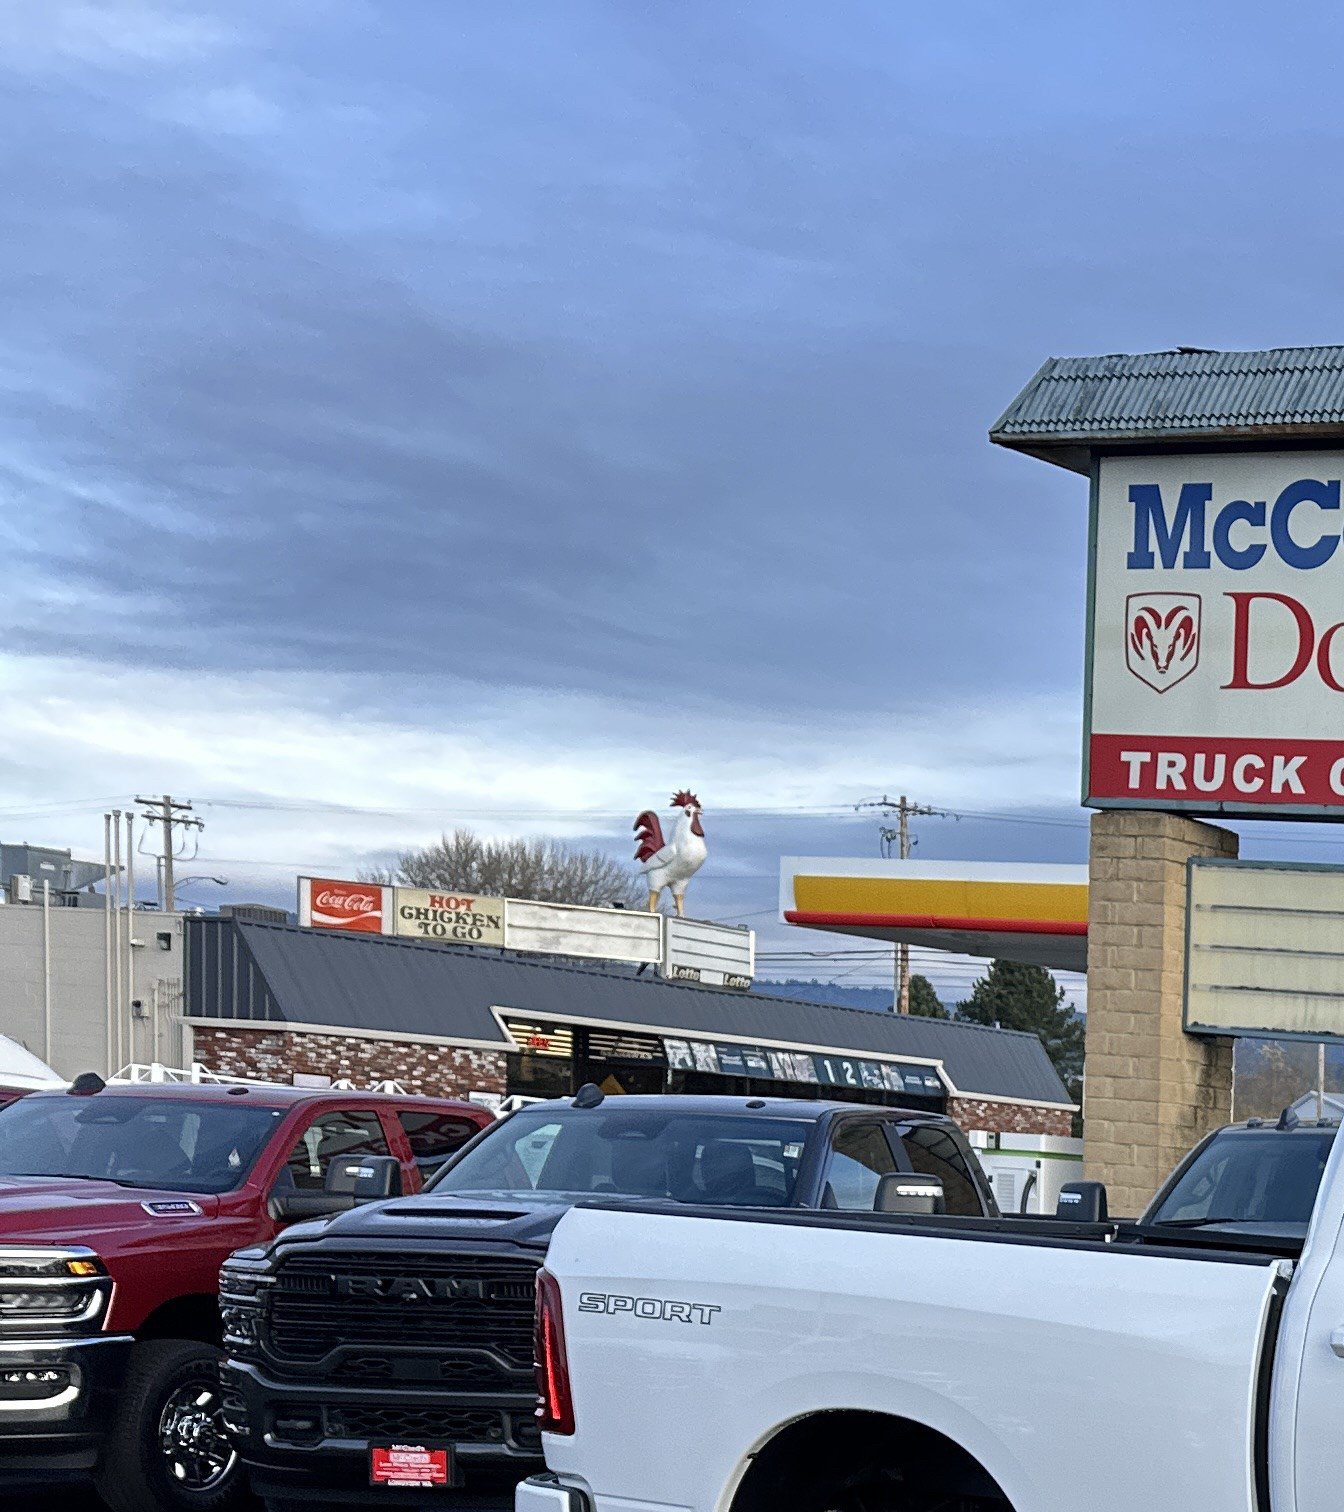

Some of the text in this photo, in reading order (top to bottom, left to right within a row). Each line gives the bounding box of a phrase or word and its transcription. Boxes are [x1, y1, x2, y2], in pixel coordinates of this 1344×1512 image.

[1120, 750, 1308, 796] TRUCK
[428, 893, 475, 912] HOT
[400, 904, 501, 930] CHICKEN
[418, 920, 482, 940] TO GO
[578, 1292, 722, 1325] SPORT
